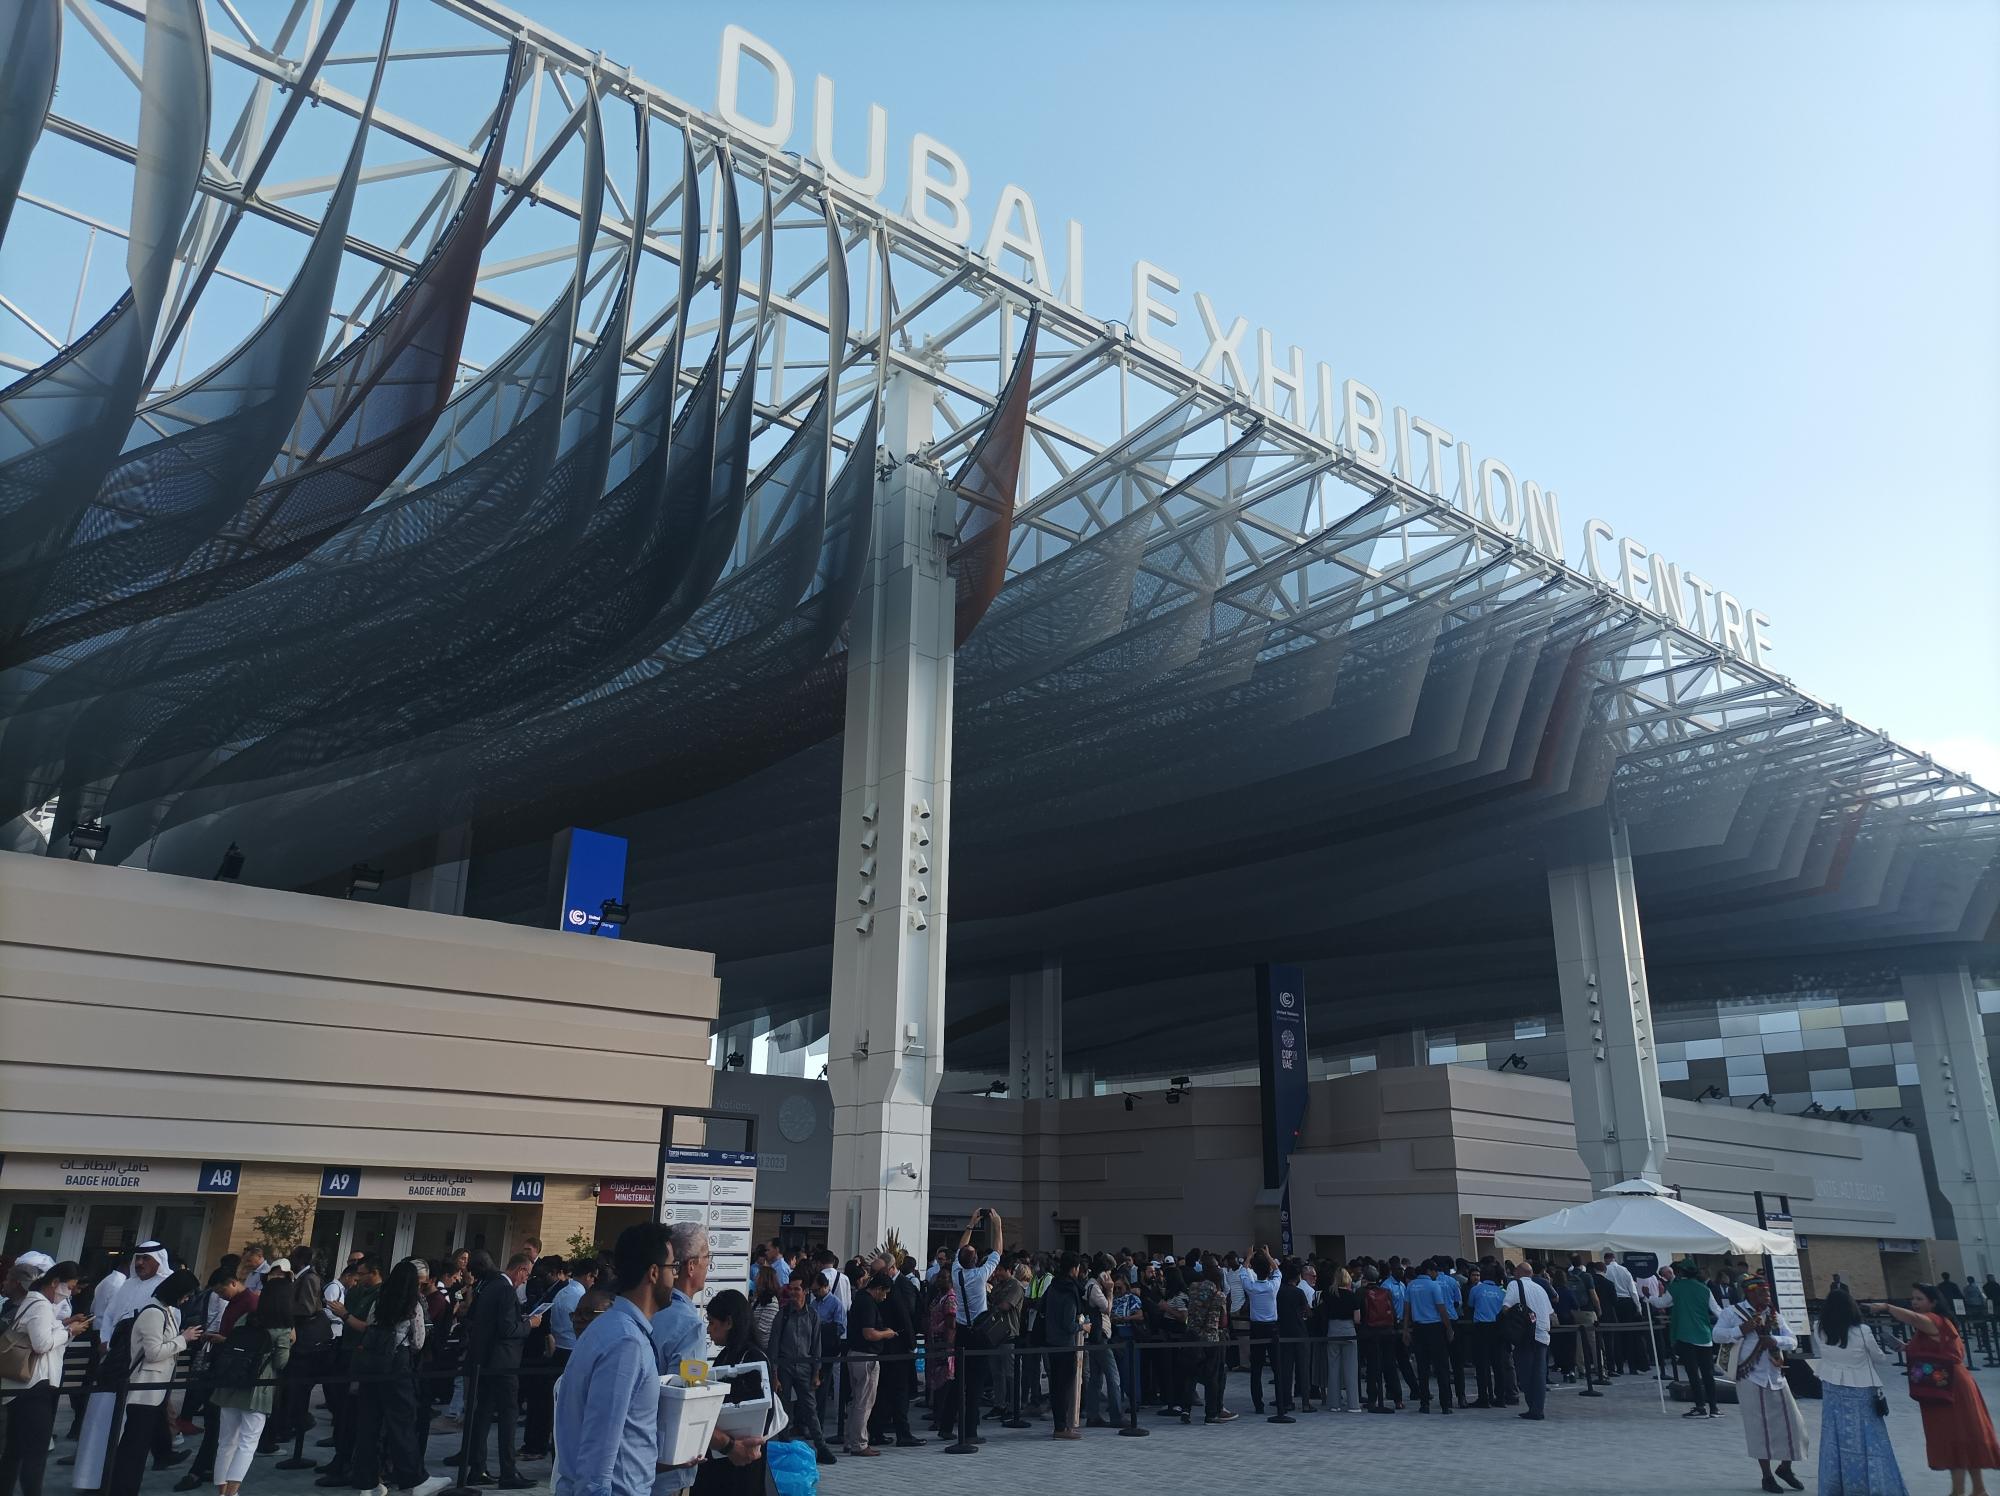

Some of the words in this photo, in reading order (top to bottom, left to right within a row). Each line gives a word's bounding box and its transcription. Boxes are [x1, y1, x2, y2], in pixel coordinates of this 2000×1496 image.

[718, 24, 1084, 312] DUBAI
[1132, 260, 1566, 563] EXHIBITION
[1584, 518, 1777, 676] CENTRE
[65, 1175, 99, 1186] BADGE
[101, 1176, 140, 1187] HOLDER
[210, 1169, 232, 1186] A8
[329, 1173, 350, 1190] A9
[408, 1186, 435, 1195] BADGE
[436, 1187, 466, 1197] HOLDER
[516, 1181, 541, 1197] A10
[614, 1193, 652, 1201] MINISTERIAL
